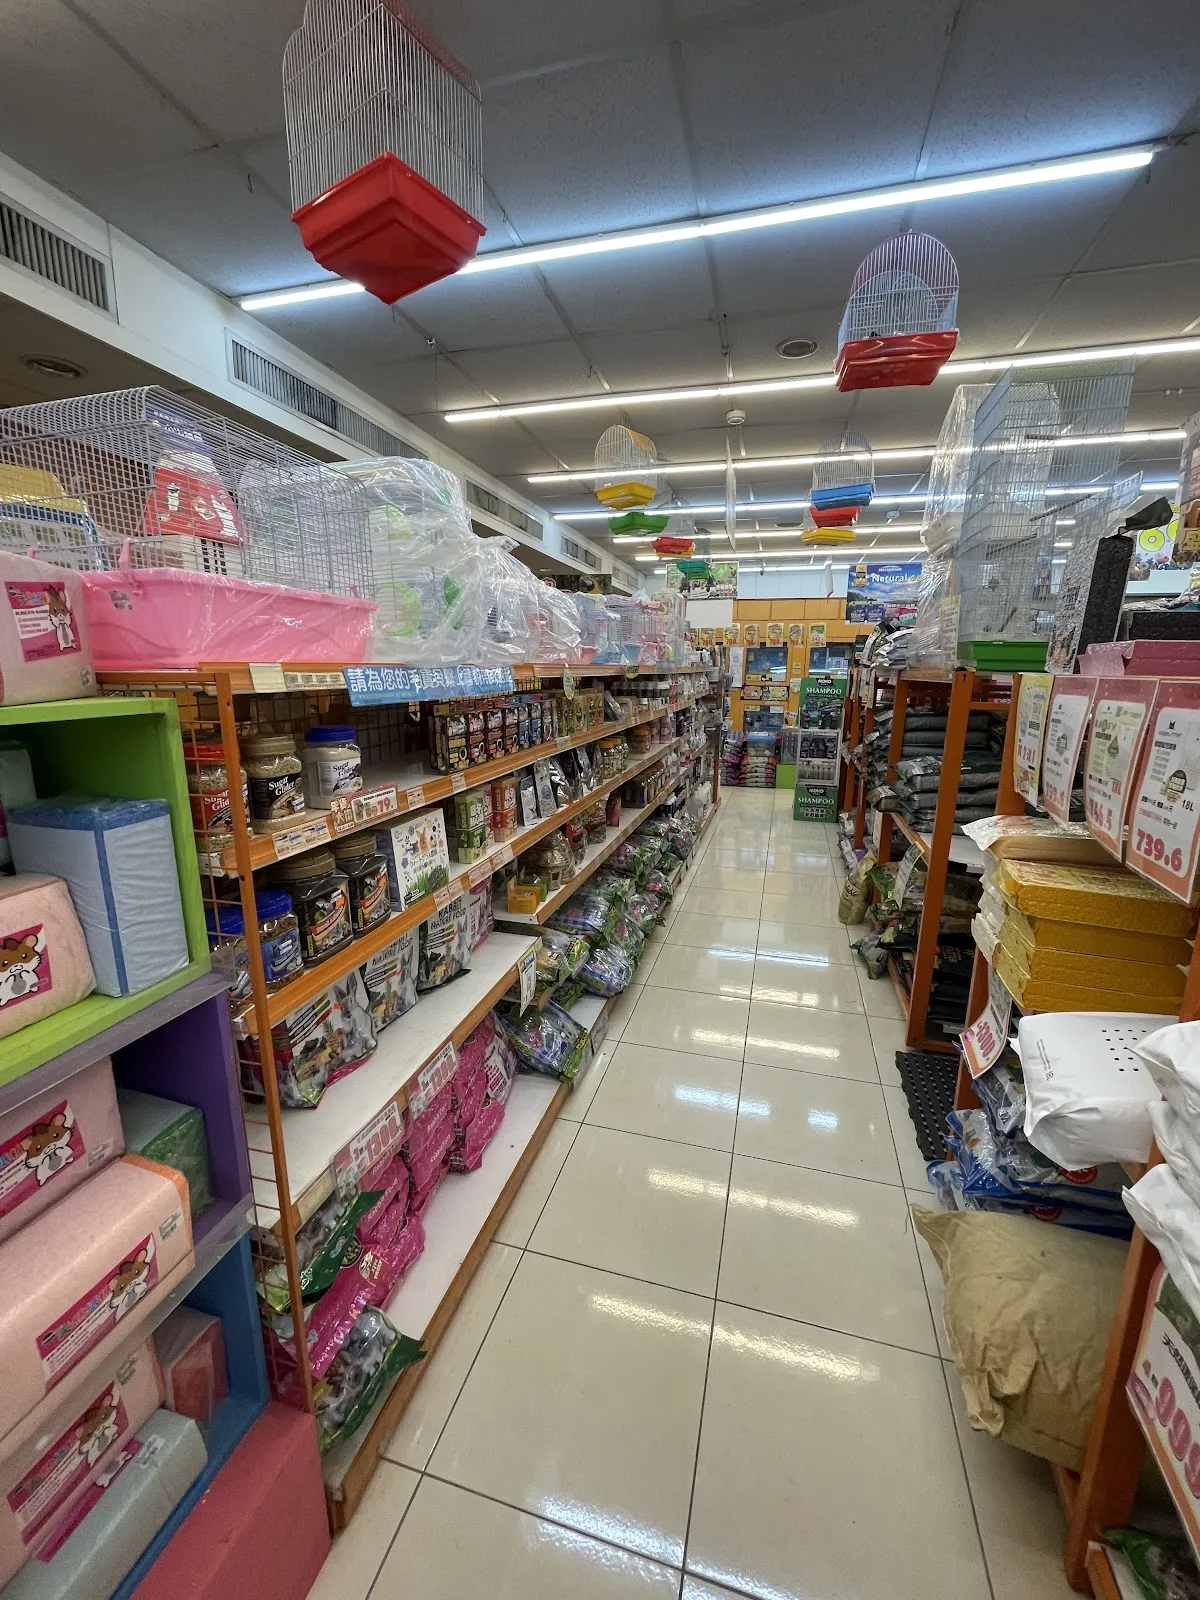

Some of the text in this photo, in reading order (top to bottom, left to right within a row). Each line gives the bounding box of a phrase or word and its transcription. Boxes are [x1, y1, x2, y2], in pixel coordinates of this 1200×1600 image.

[871, 573, 908, 583] Natural
[806, 687, 842, 695] SHAMPOO
[268, 775, 290, 791] Sugar
[275, 781, 296, 796] Glider
[797, 796, 835, 805] SHAMPOO
[1181, 799, 1195, 812] 18L
[1135, 827, 1183, 873] 739.6
